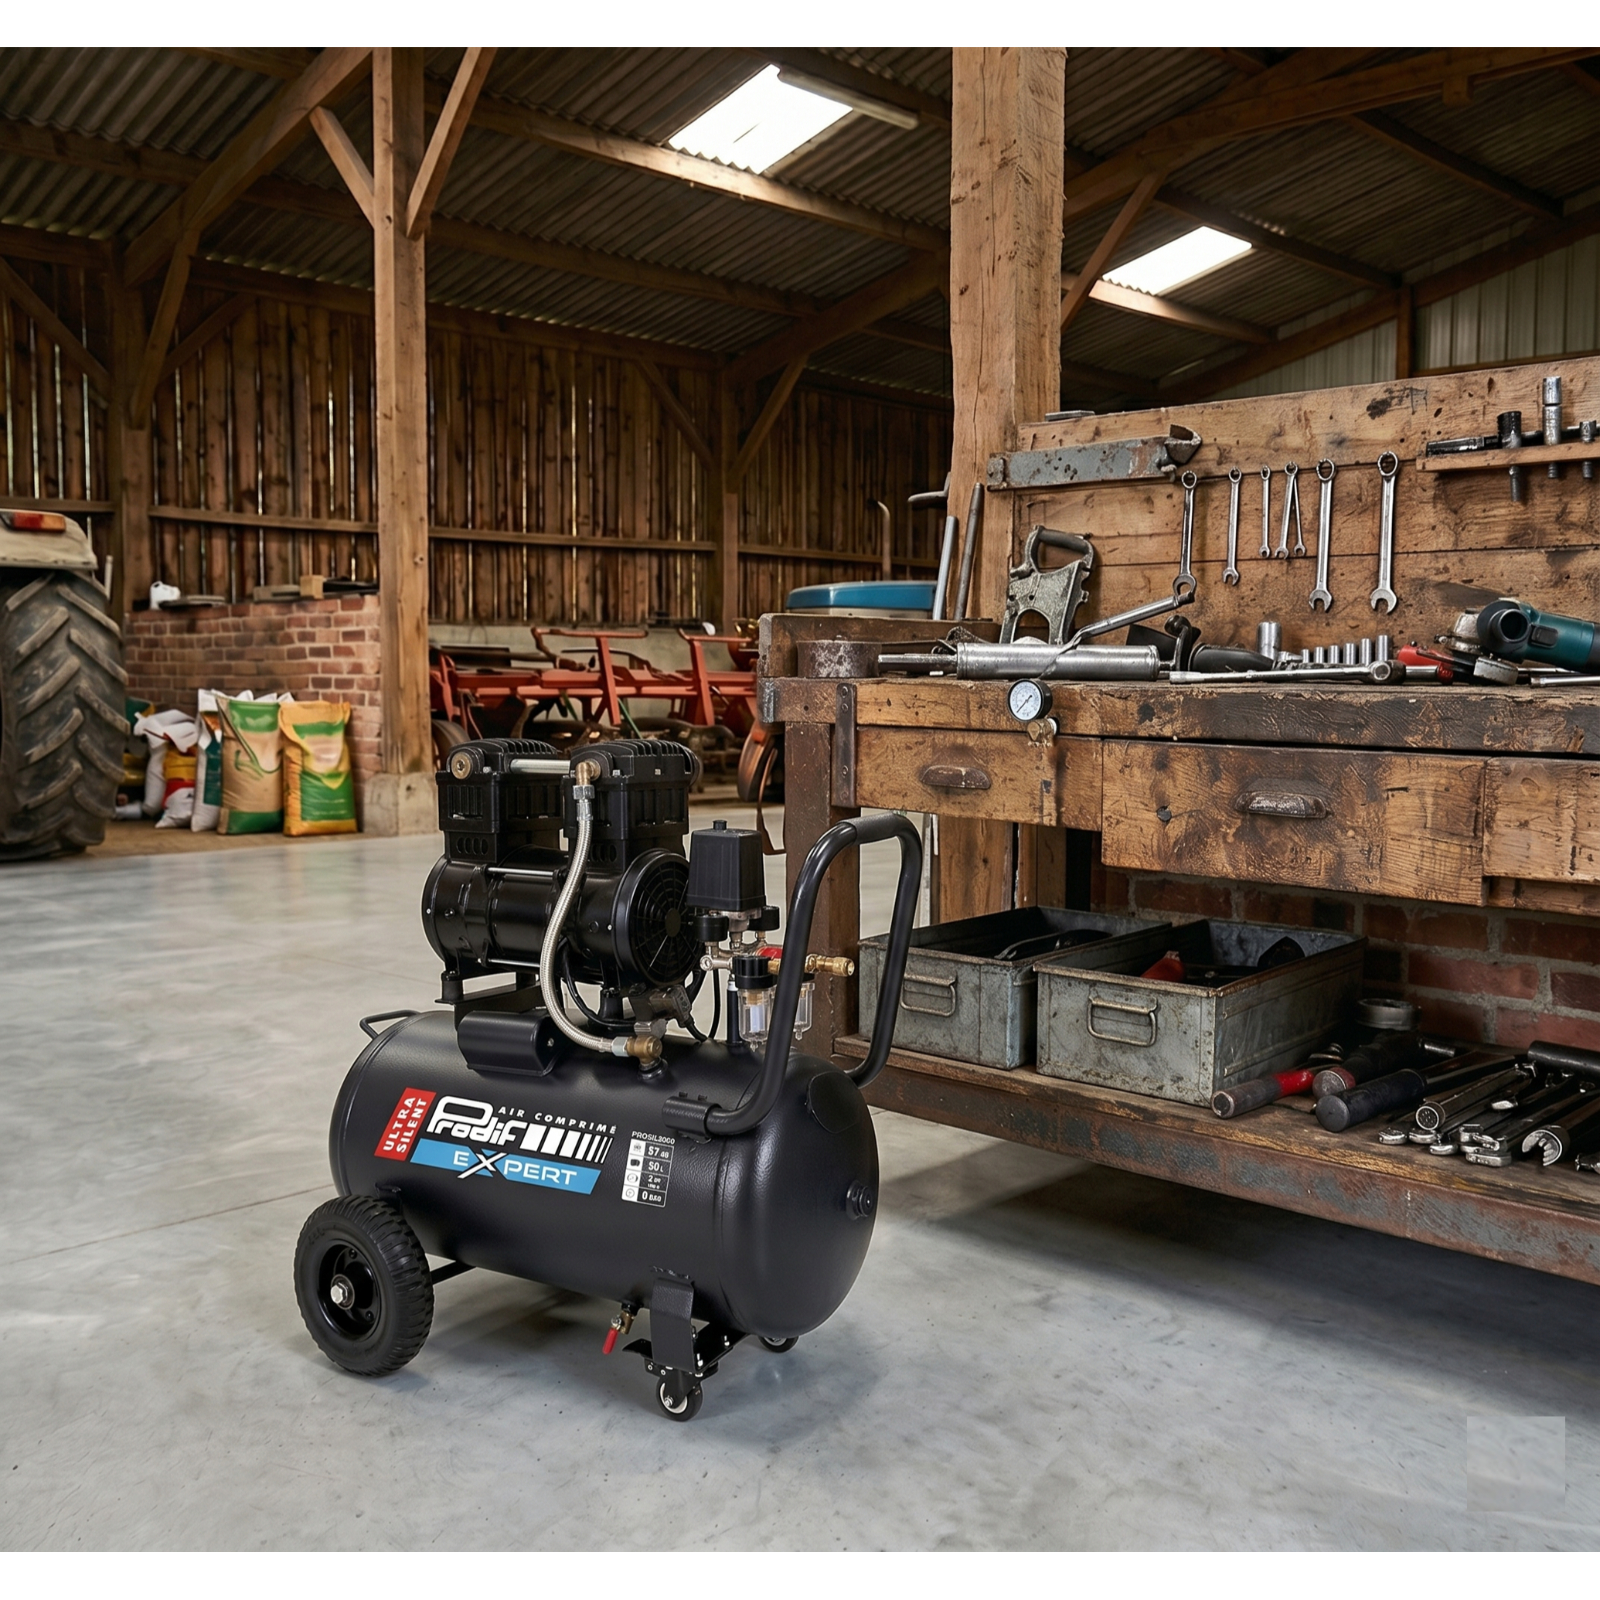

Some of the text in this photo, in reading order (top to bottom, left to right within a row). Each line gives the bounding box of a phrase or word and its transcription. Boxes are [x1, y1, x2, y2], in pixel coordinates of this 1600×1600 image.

[382, 1097, 415, 1151] ULTRA
[396, 1098, 427, 1153] SILENT
[498, 1106, 617, 1134] AIR COMPRIMÉ
[453, 1150, 577, 1185] EXPERT
